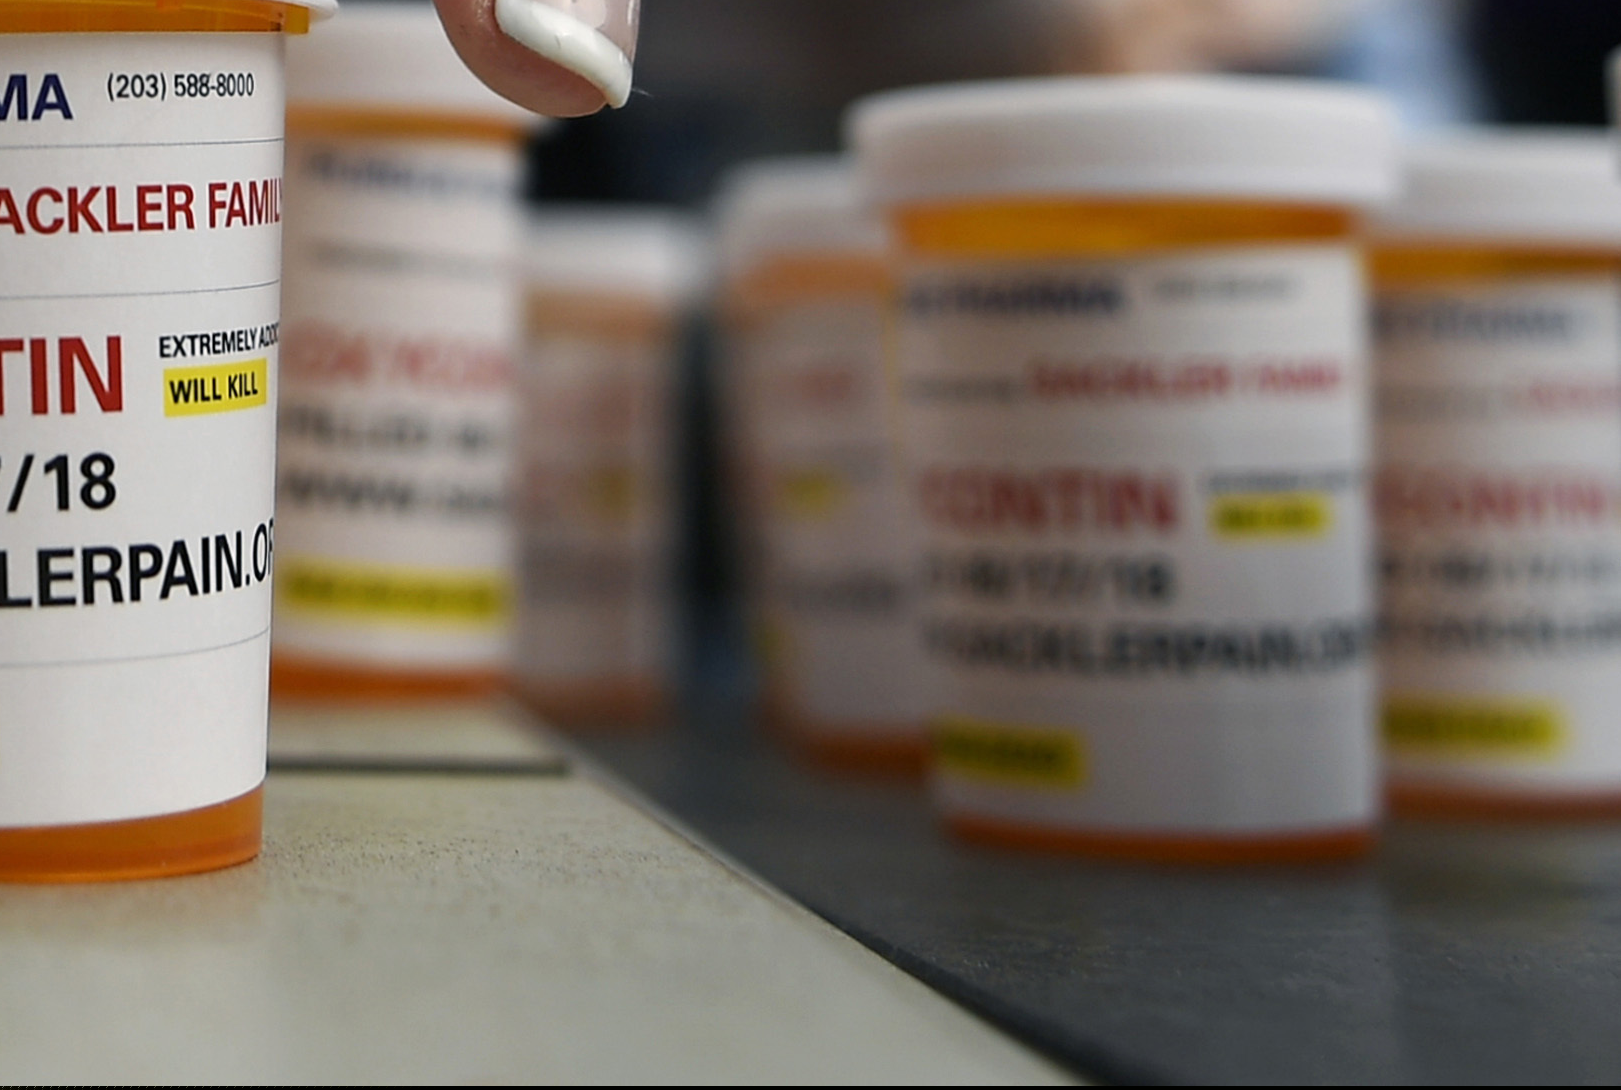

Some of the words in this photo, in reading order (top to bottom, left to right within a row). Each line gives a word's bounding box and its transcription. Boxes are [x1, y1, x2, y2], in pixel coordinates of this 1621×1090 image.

[106, 70, 168, 102] (203)
[173, 70, 255, 99] 588-8000
[158, 326, 257, 358] EXTREMELY
[169, 376, 222, 405] WILL
[227, 370, 258, 400] KILL
